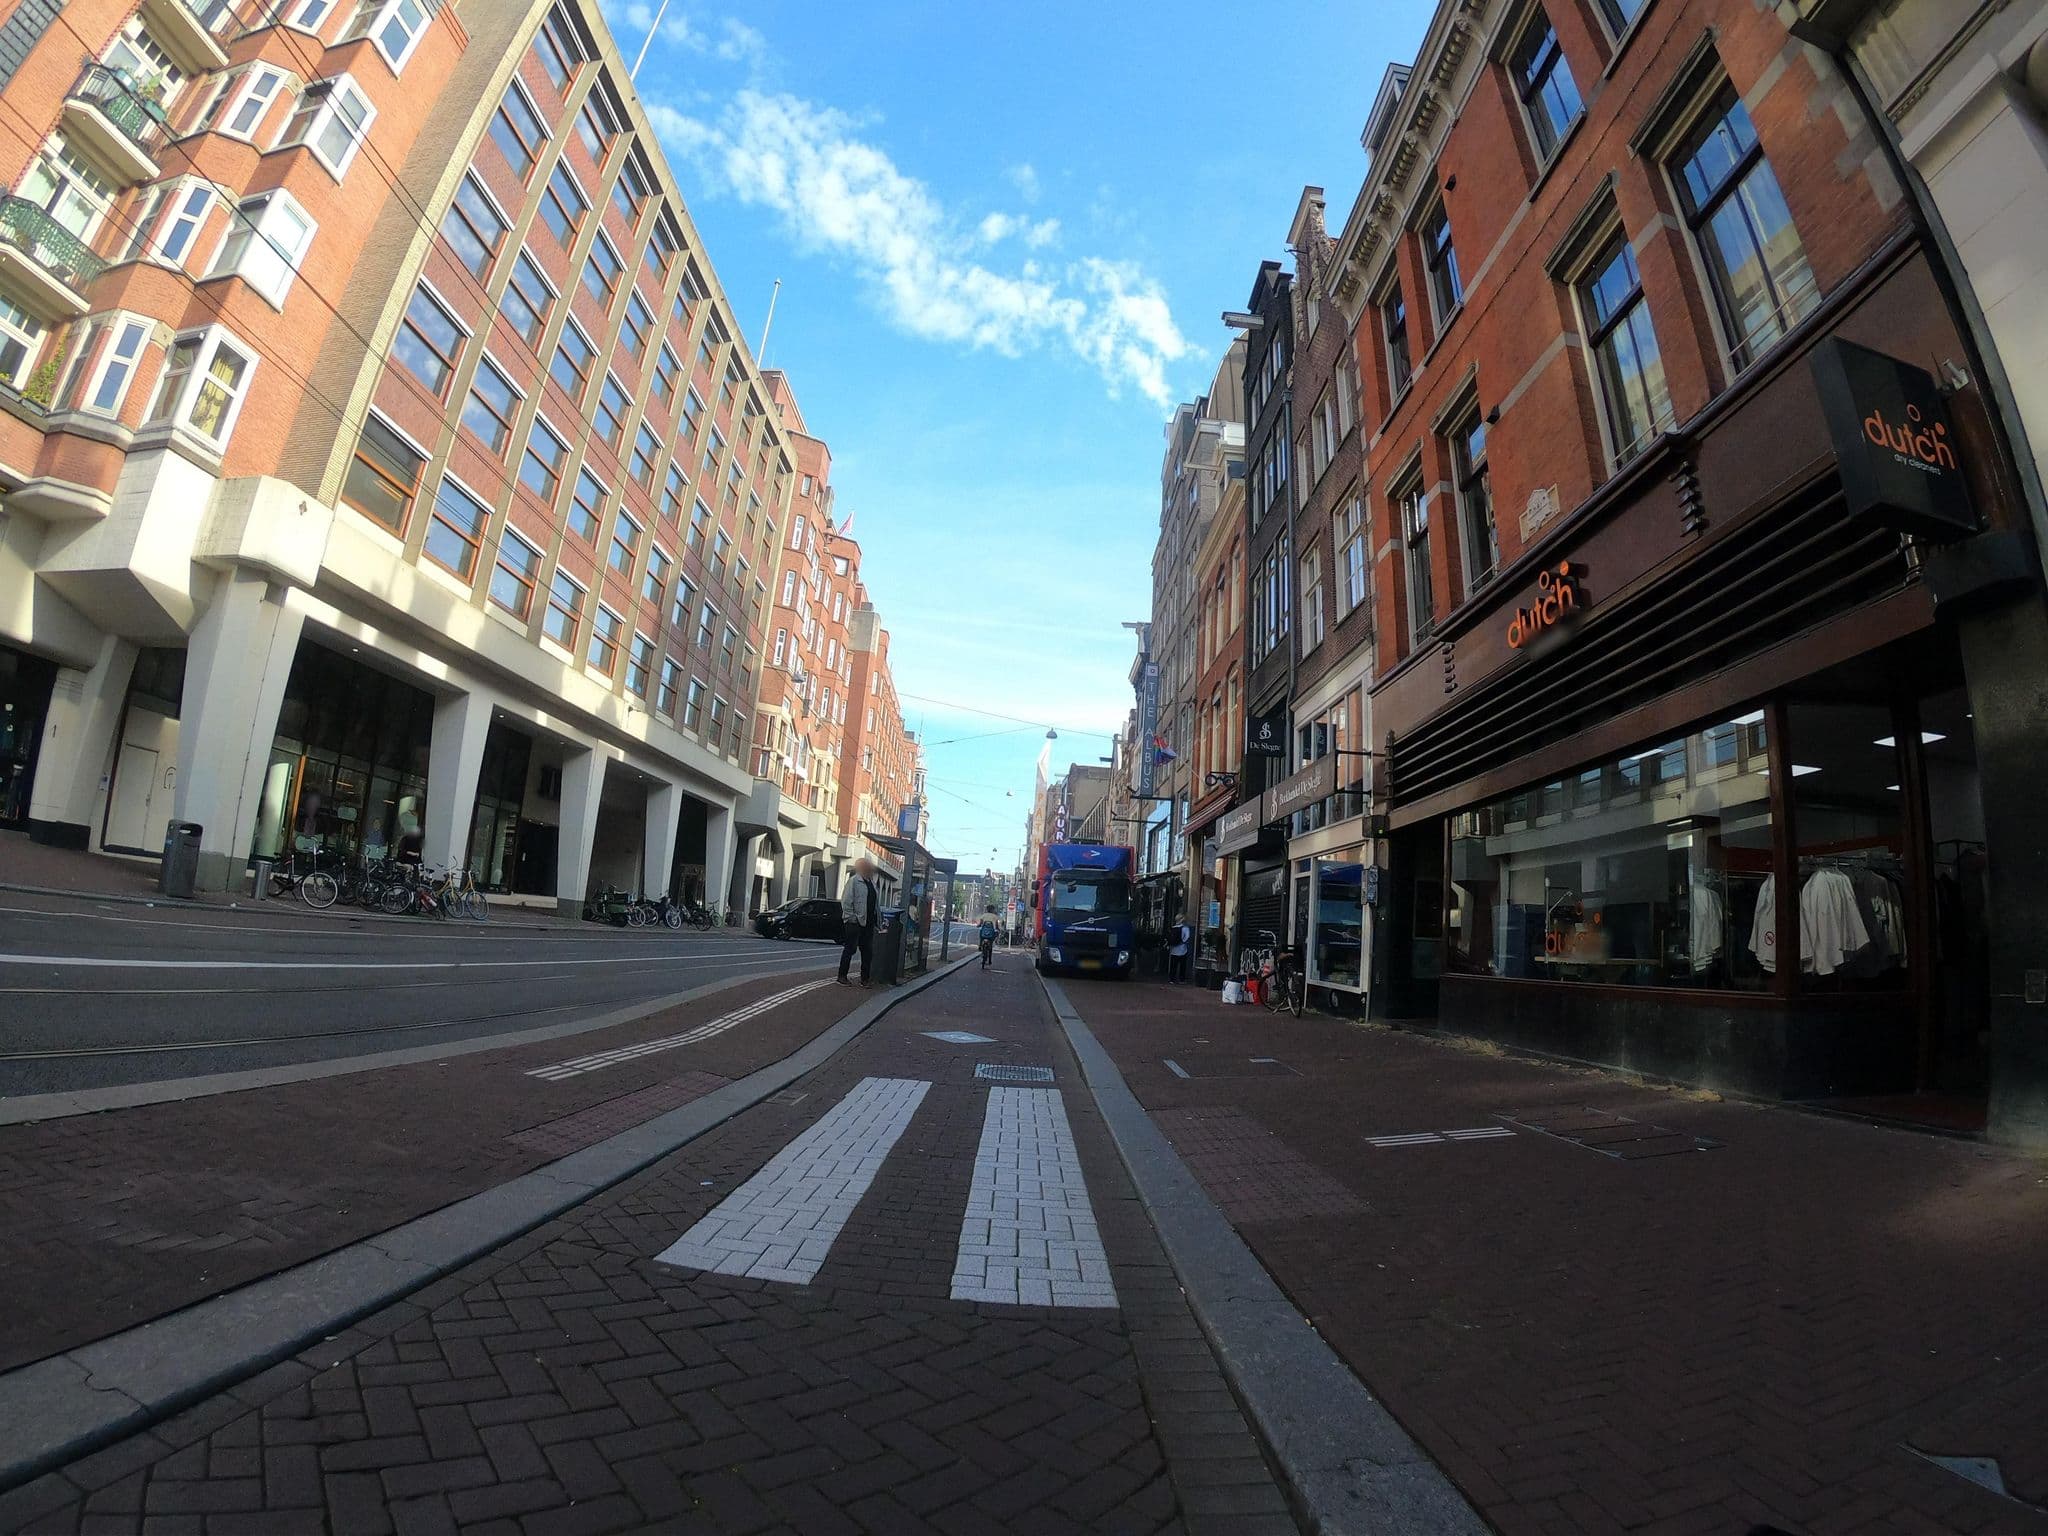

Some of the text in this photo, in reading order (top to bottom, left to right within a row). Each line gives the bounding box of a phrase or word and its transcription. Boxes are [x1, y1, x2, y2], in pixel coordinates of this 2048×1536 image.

[1864, 405, 1955, 470] dutch
[1507, 570, 1574, 649] dutch
[1143, 681, 1156, 789] THE ALBUS
[1056, 805, 1066, 841] AUR
